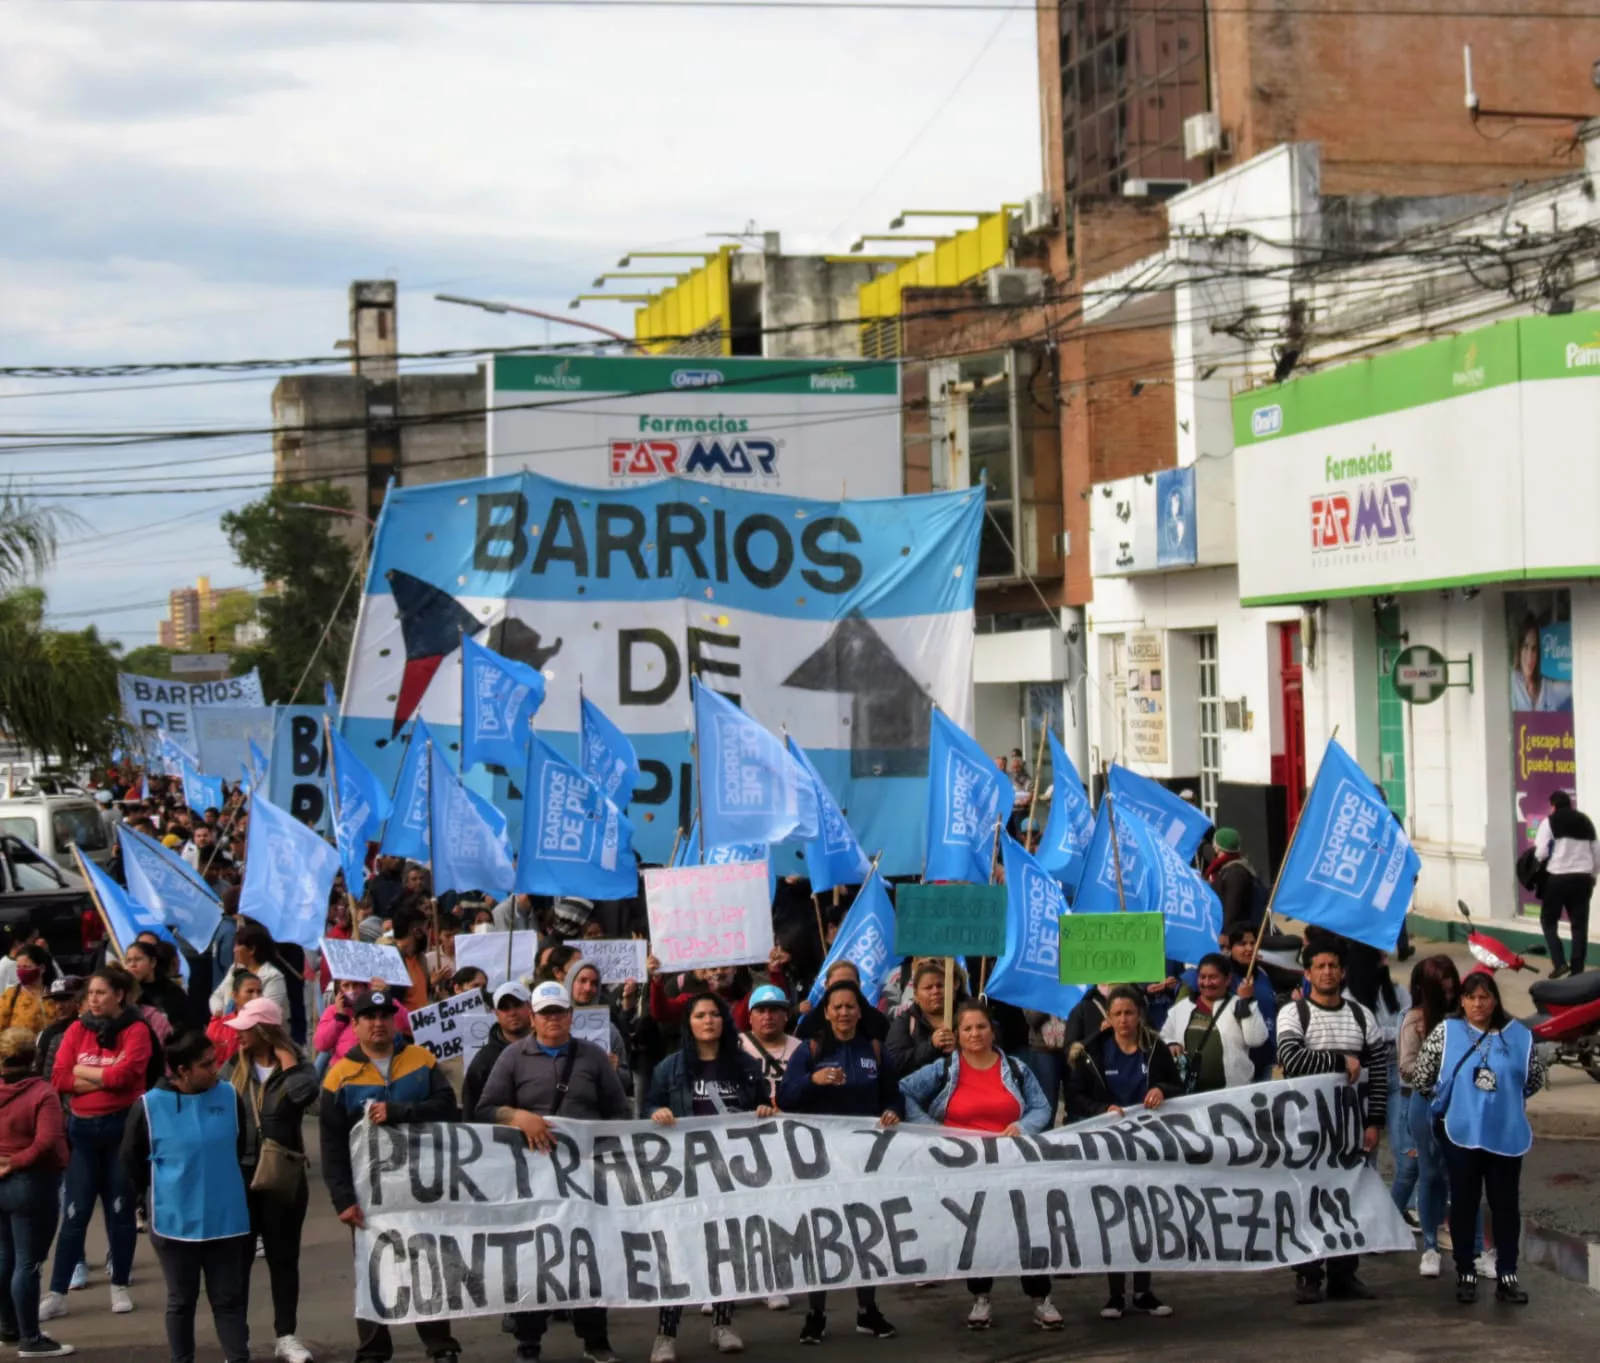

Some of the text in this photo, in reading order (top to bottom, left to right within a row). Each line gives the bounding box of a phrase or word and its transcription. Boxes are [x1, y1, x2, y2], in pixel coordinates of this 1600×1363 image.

[638, 413, 749, 432] Farmacias
[1326, 444, 1393, 483] Farmacias
[472, 491, 864, 594] BARRIOS
[133, 680, 244, 705] BARRIOS
[617, 627, 742, 706] DE
[139, 708, 188, 733] DE
[543, 769, 567, 850] BARRIOS
[560, 775, 590, 852] DE PIE
[1318, 790, 1361, 878] BARRIOS
[1333, 800, 1379, 886] DE PIE
[1026, 874, 1045, 963] BARRIOS
[1036, 926, 1060, 968] DE
[440, 1018, 457, 1033] LA
[367, 1122, 487, 1206] POR
[492, 1118, 831, 1206] TRABAJO
[852, 1130, 897, 1174] Y
[367, 1222, 603, 1320] CONTRA
[620, 1229, 691, 1301] EL
[703, 1196, 927, 1298] HAMBRE
[940, 1190, 987, 1271] Y
[1009, 1188, 1082, 1270] LA
